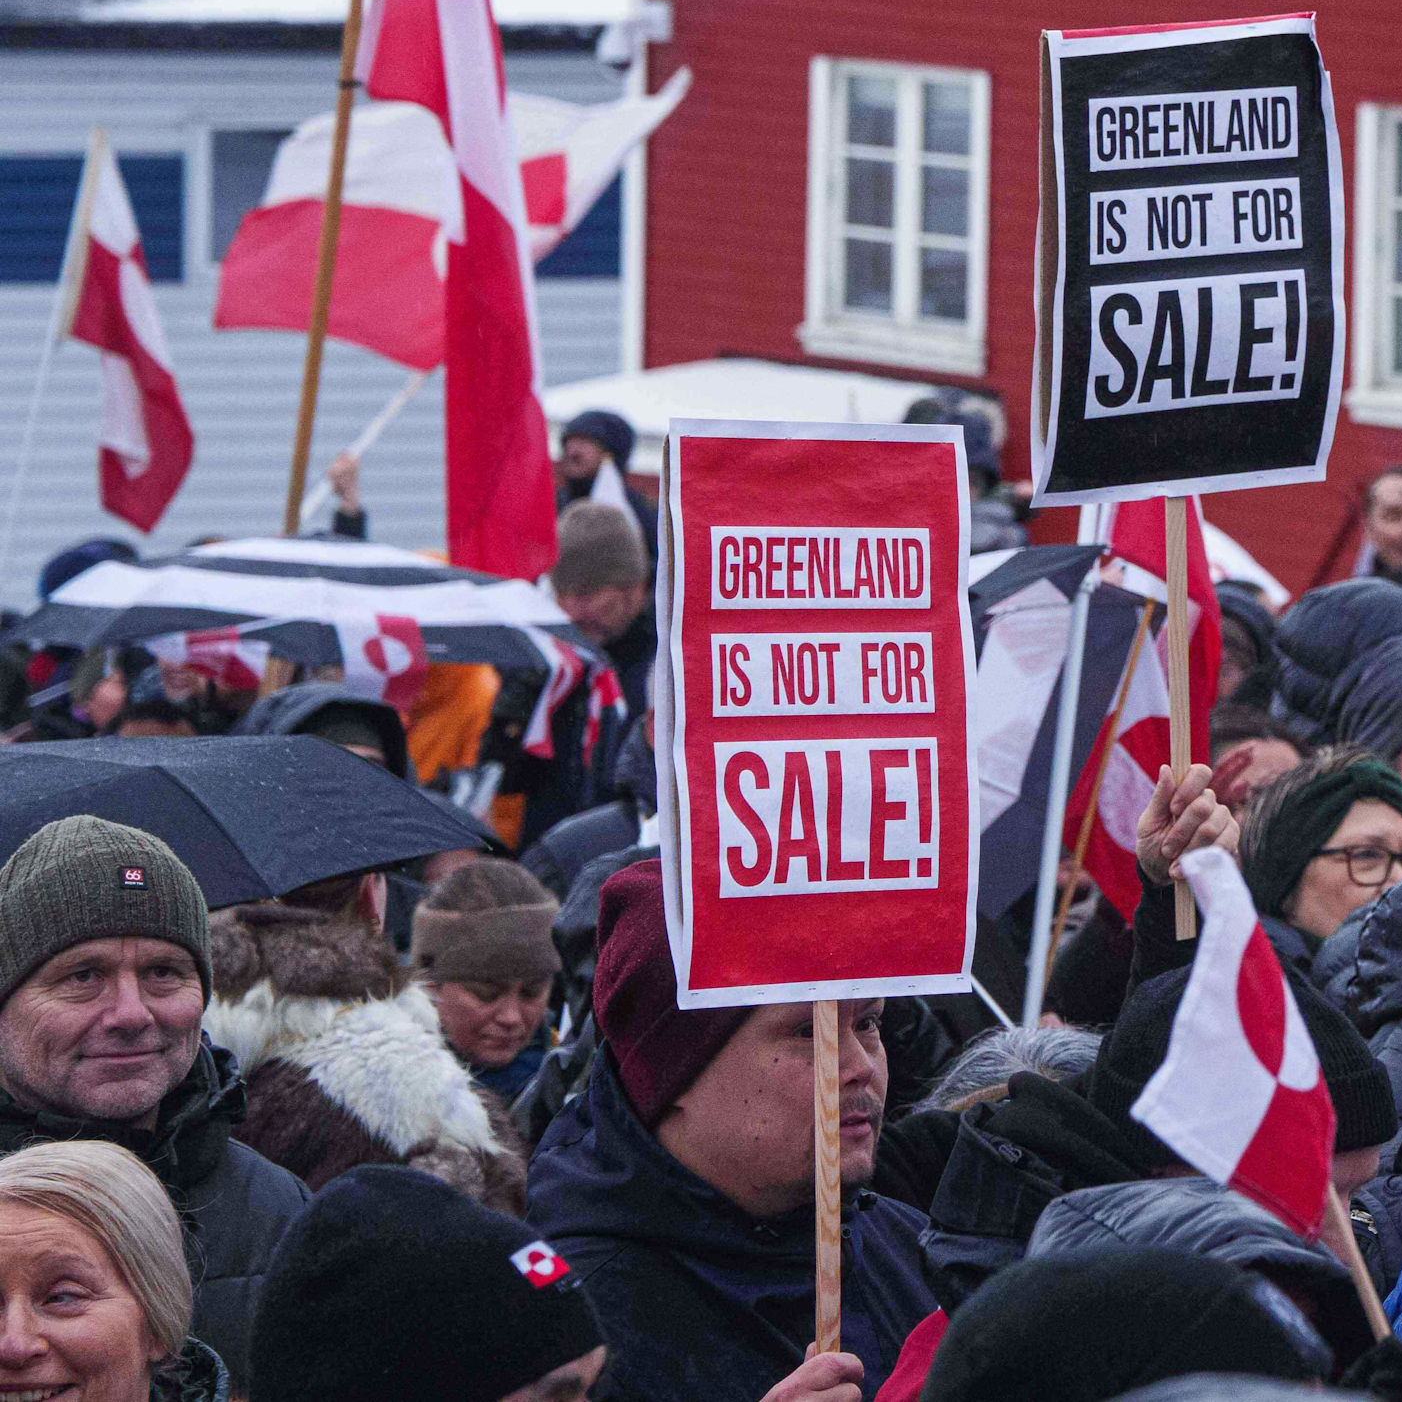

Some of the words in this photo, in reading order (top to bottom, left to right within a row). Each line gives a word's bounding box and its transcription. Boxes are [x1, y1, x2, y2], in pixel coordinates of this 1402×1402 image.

[1095, 96, 1292, 163] GREENLAND
[1096, 199, 1127, 256] IS
[1147, 192, 1213, 252] NOT
[1232, 187, 1296, 245] FOR
[1093, 279, 1301, 409] SALE!
[718, 535, 924, 600] GREENLAND
[718, 643, 752, 707] IS
[770, 642, 841, 706] NOT
[860, 641, 928, 704] FOR
[723, 748, 933, 888] SALE!
